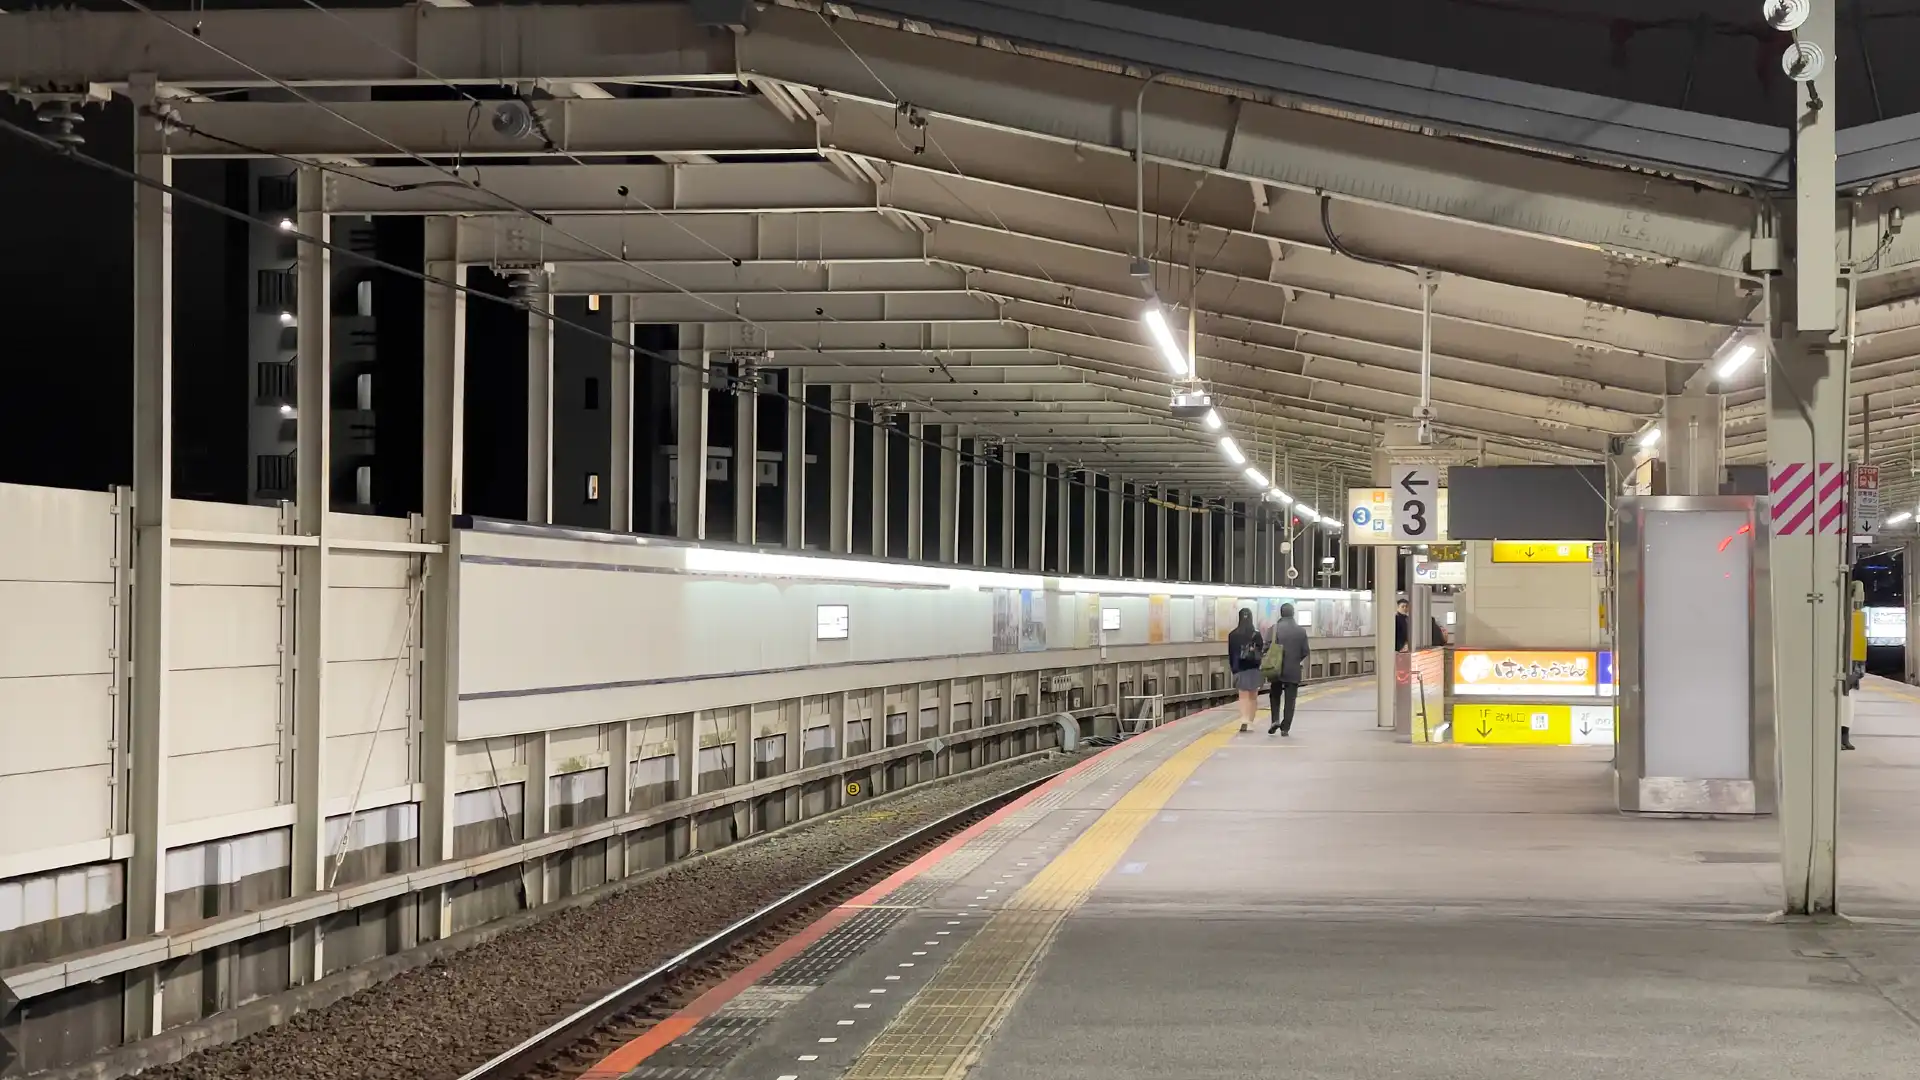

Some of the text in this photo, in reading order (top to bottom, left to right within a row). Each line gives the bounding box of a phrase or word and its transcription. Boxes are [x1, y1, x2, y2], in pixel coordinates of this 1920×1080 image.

[1357, 509, 1367, 523] 3
[1402, 499, 1427, 536] 3
[1494, 658, 1586, 679] はなまるうどん
[1479, 709, 1491, 718] 1F
[849, 784, 857, 793] B
